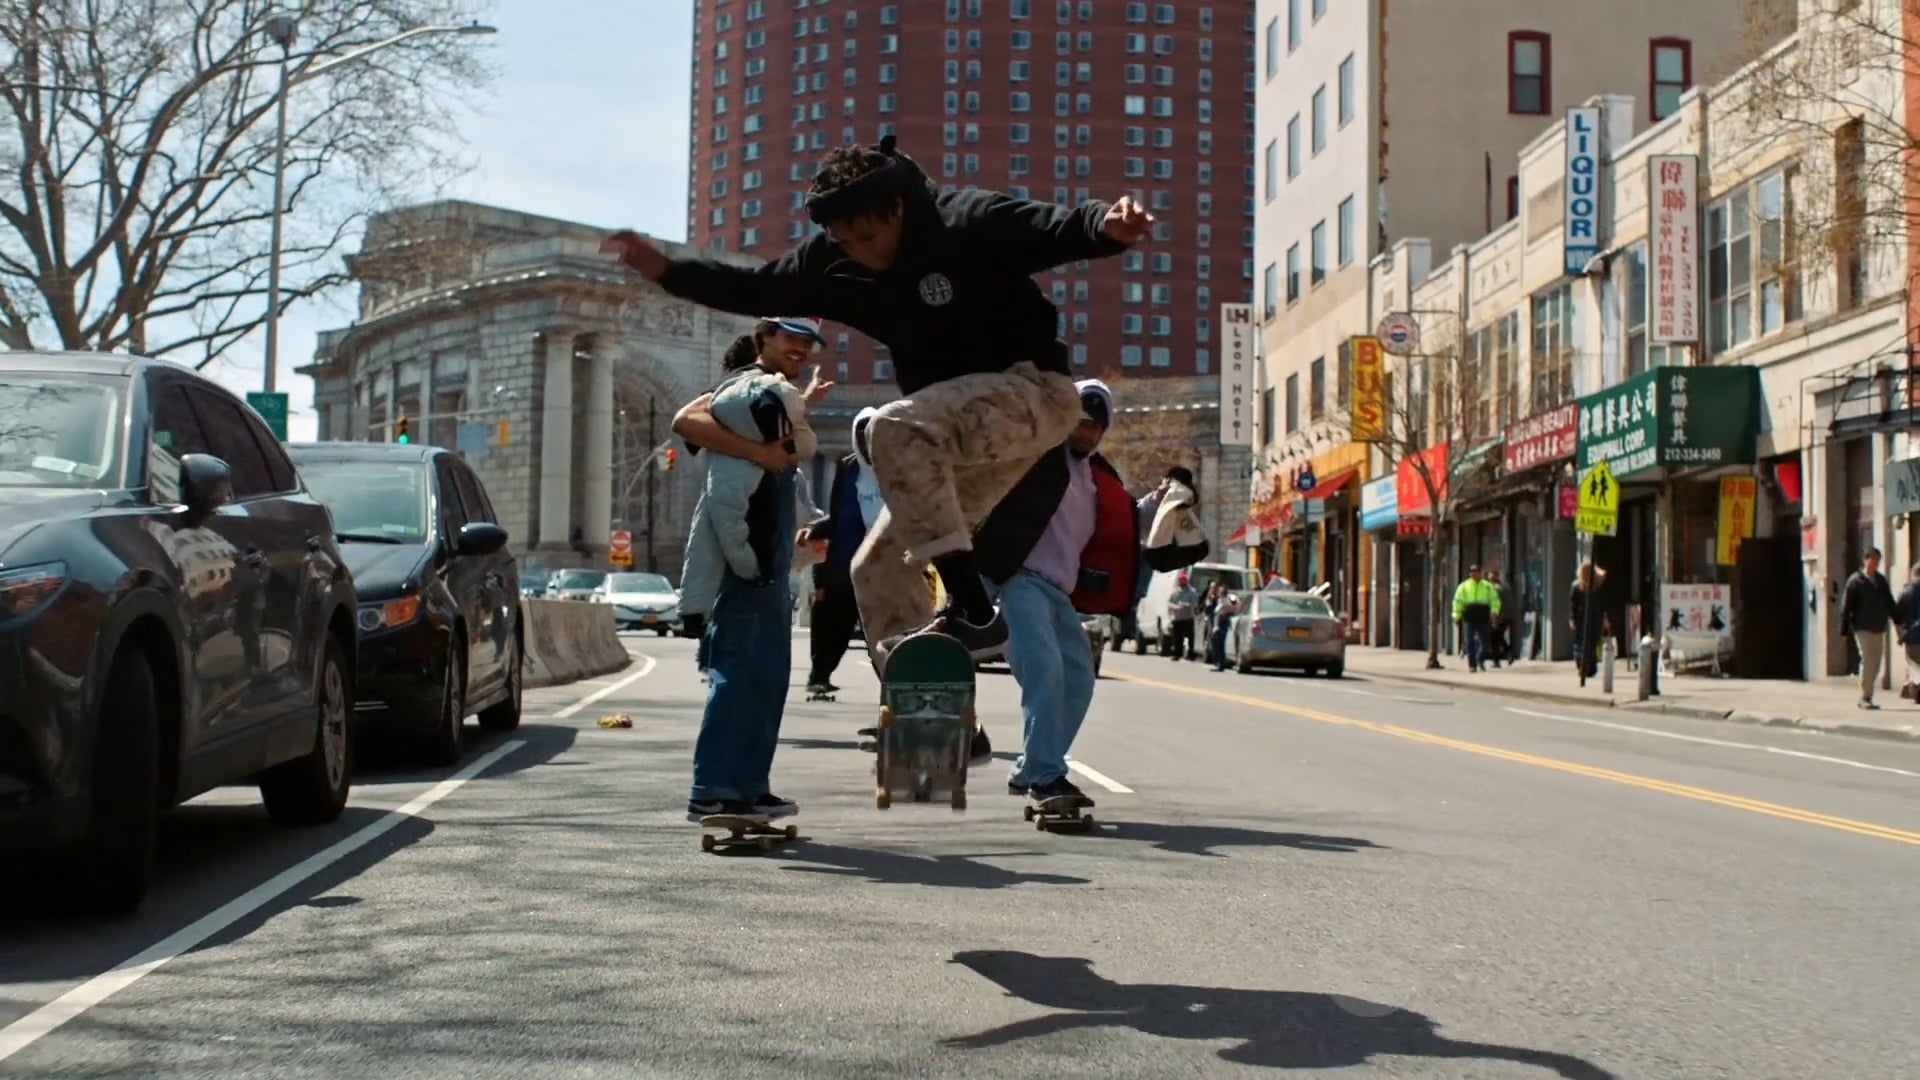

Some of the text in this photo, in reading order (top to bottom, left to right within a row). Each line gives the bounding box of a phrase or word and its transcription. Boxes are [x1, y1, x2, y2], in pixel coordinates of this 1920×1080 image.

[1571, 114, 1594, 237] LIQUOR
[1233, 327, 1242, 440] Leon Hotel
[1357, 340, 1381, 425] BUS
[1542, 403, 1574, 435] BEAUTY
[1579, 513, 1614, 529] AHEAD
